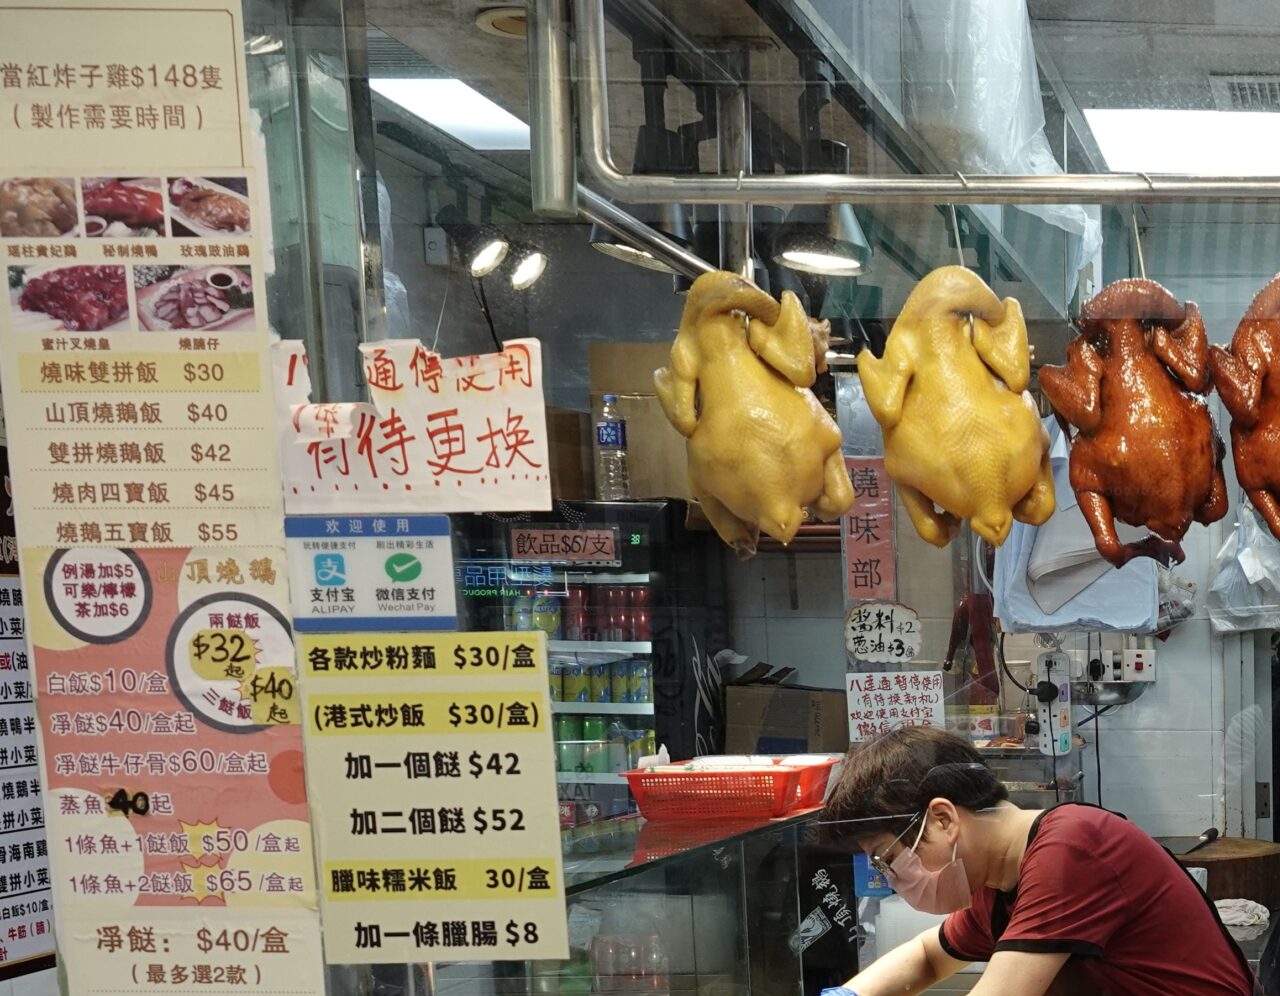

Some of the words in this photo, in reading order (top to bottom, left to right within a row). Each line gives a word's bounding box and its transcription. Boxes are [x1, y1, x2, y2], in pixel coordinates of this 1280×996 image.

[40, 361, 159, 384] 燒味雙拼飯
[184, 363, 224, 382] $30
[45, 402, 163, 424] 山頂燒鵝飯
[186, 403, 228, 423] $40
[48, 441, 166, 464] 雙拼燒鵝飯
[190, 443, 232, 463] $42
[52, 481, 170, 504] 燒肉四寶飯
[194, 483, 235, 503] $45
[56, 521, 174, 544] 燒鵝五寶飯
[197, 523, 239, 542] $55
[325, 518, 411, 534] 欢迎使用
[310, 587, 356, 603] 支付宝
[375, 587, 436, 602] 微信支付
[74, 602, 129, 618] 茶加$6
[311, 605, 356, 614] ALIPAY
[378, 602, 415, 612] Wechat
[417, 603, 436, 613] Pay
[192, 633, 252, 663] $32
[308, 645, 437, 672] 各款炒粉麵
[453, 644, 536, 672] $30/盒
[48, 668, 167, 695] 白飯$10/盒
[251, 671, 293, 702] $40
[468, 751, 521, 779] $42
[473, 807, 526, 835] $52
[485, 865, 551, 893] 30/盒
[196, 926, 290, 954] $40/盒
[505, 920, 539, 947] $8
